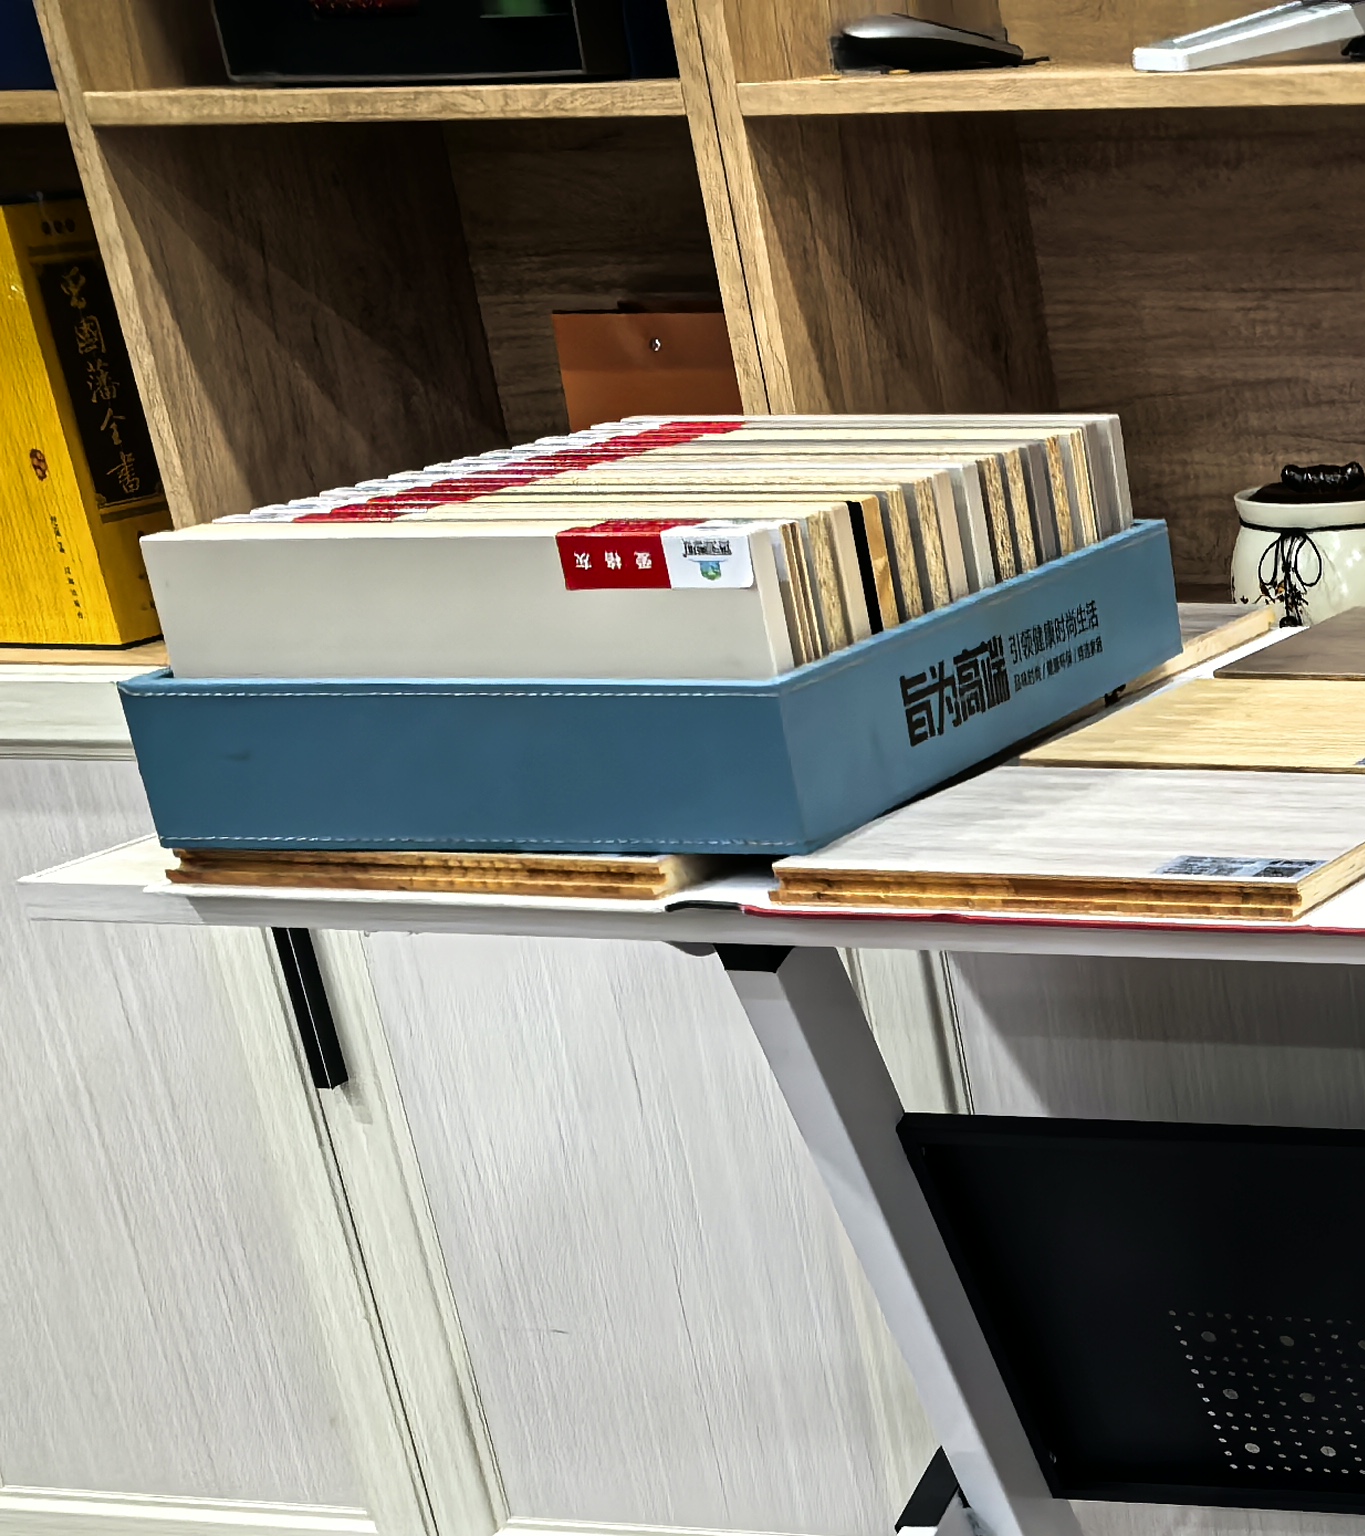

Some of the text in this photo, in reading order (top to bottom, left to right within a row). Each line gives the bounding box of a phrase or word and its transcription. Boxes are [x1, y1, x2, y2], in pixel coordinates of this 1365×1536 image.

[574, 550, 653, 570] 爱格灰
[1008, 599, 1099, 664] 引领健康时尚生活
